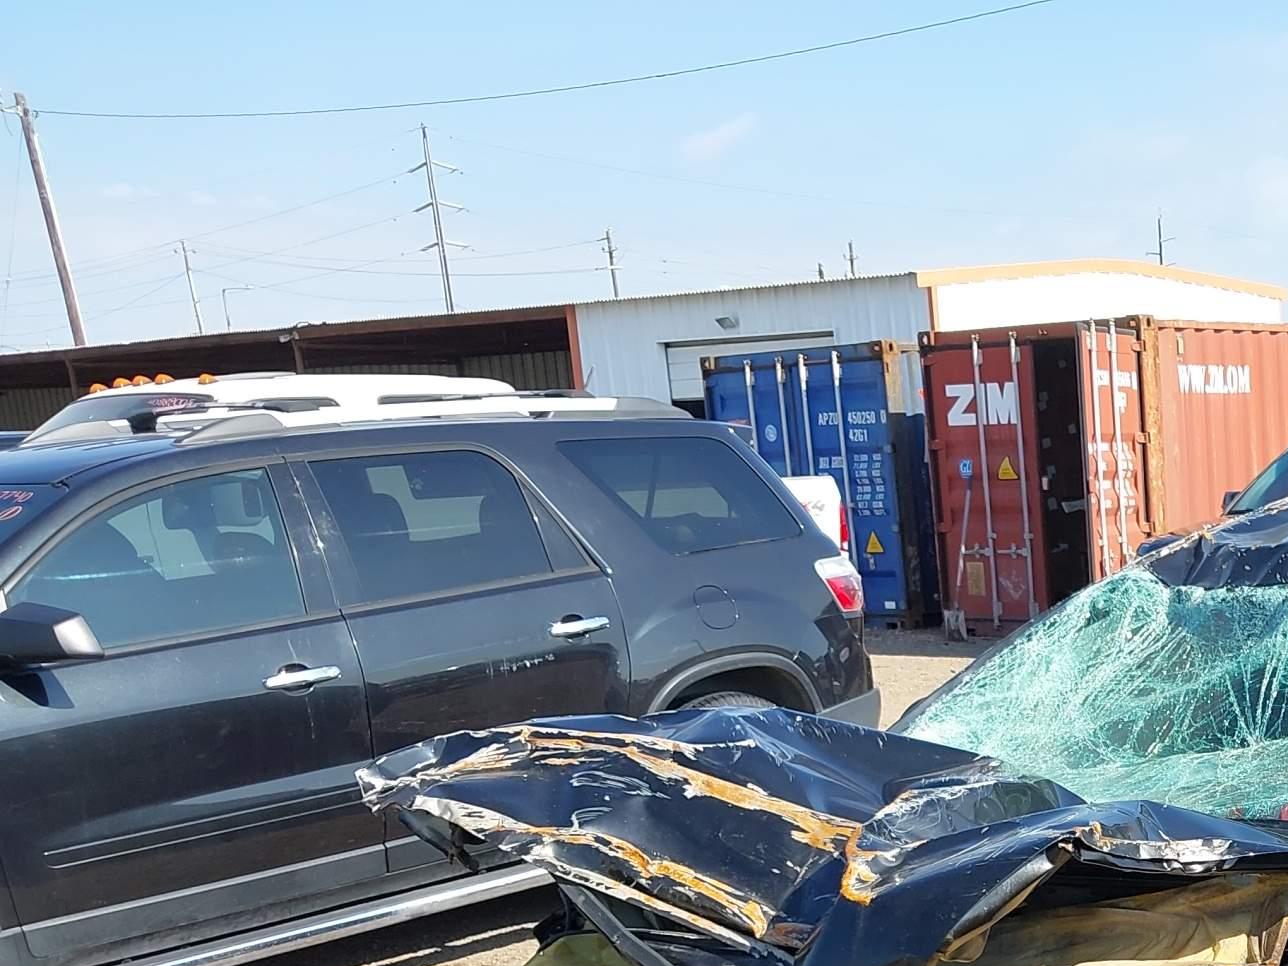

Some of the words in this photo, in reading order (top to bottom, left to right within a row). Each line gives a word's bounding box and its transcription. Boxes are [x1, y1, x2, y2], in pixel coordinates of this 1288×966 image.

[945, 382, 1018, 427] ZIM
[818, 411, 840, 426] APZU
[849, 428, 868, 442] 42G1
